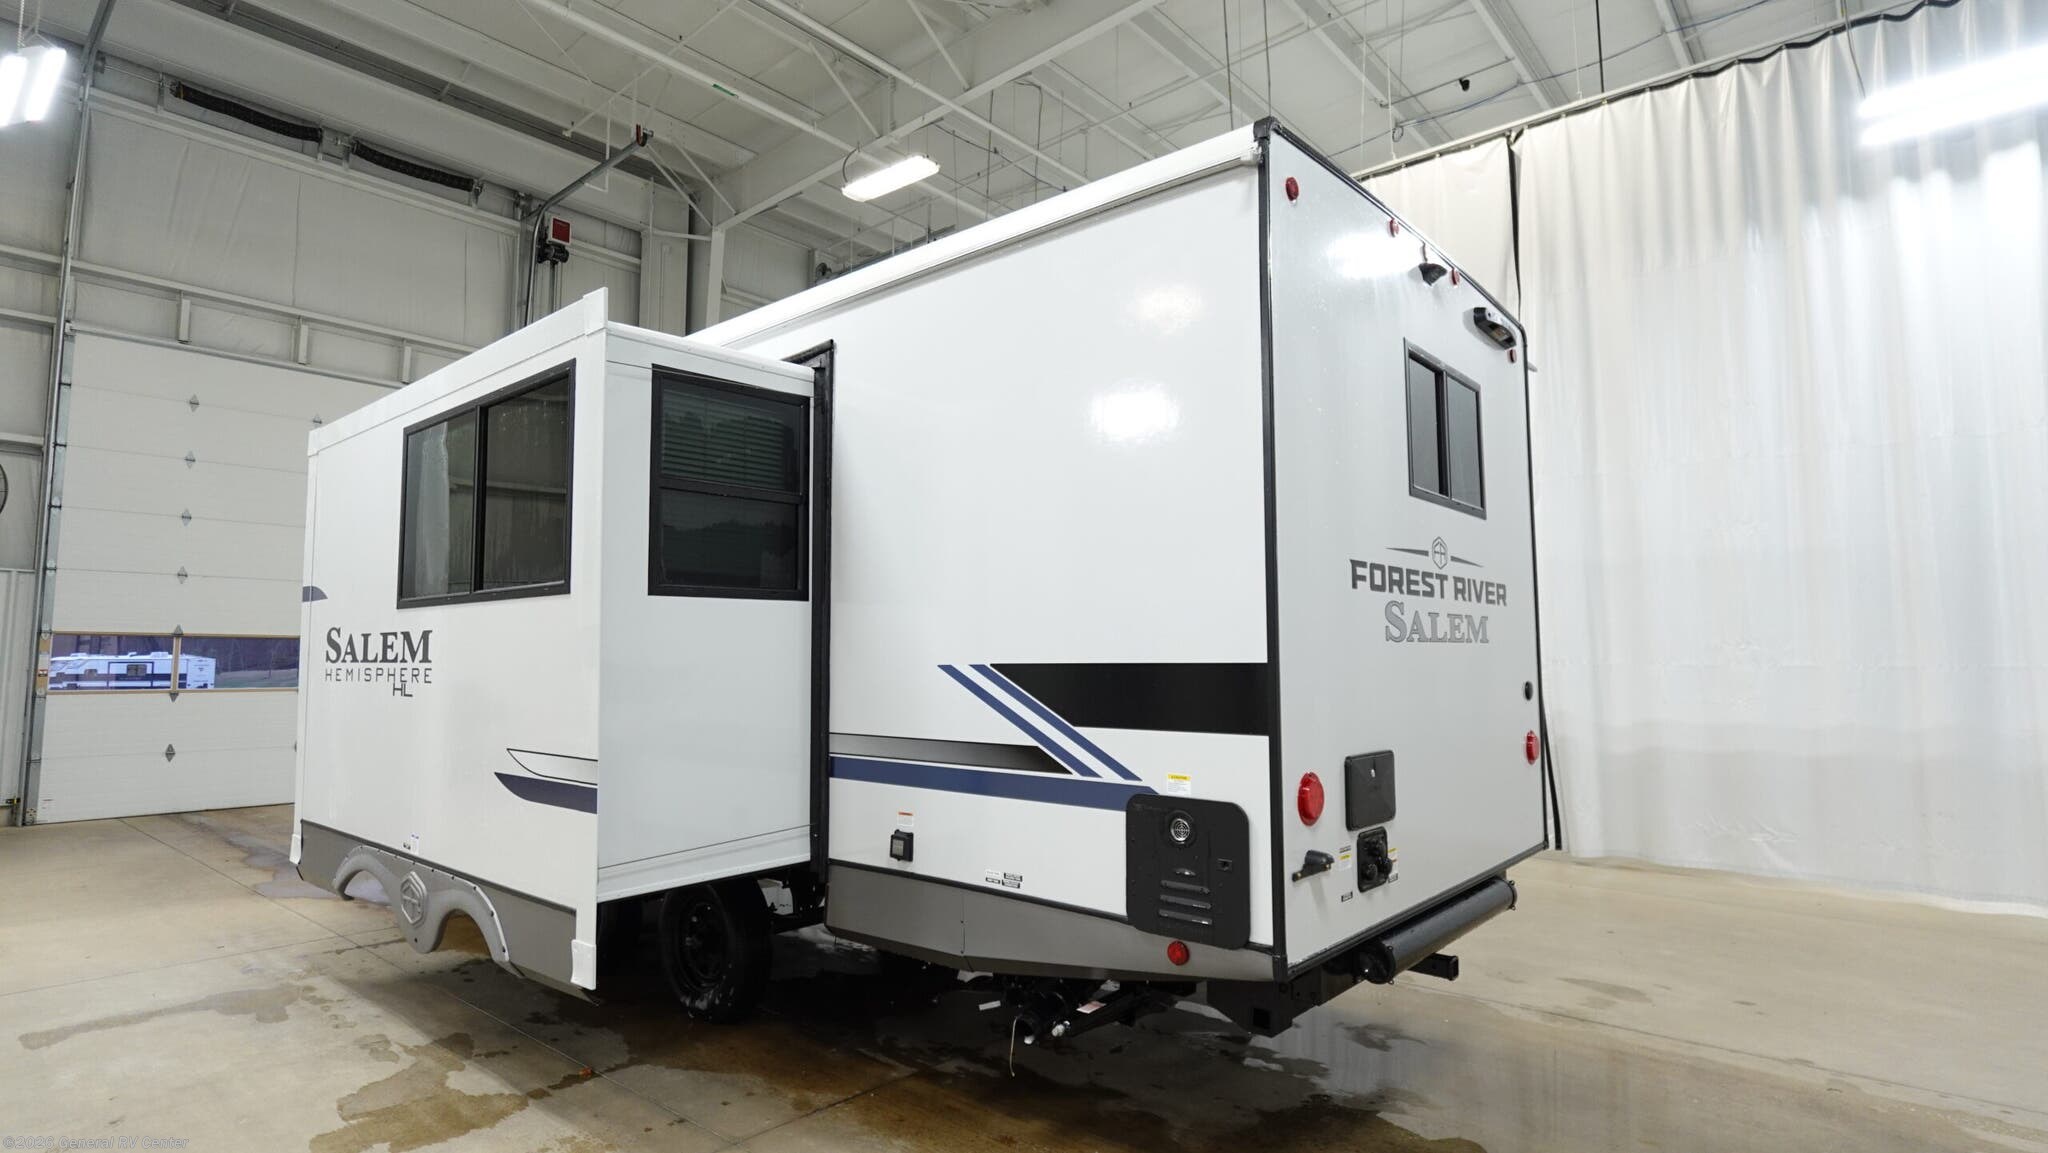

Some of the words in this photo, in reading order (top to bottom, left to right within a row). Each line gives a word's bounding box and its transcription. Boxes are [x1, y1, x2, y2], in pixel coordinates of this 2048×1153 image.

[1350, 559, 1448, 599] FOREST
[1452, 575, 1508, 607] RIVER
[1384, 600, 1489, 644] SALEM
[325, 627, 432, 663] SALEM
[325, 667, 432, 683] HEMISPHERE
[392, 682, 413, 697] HL
